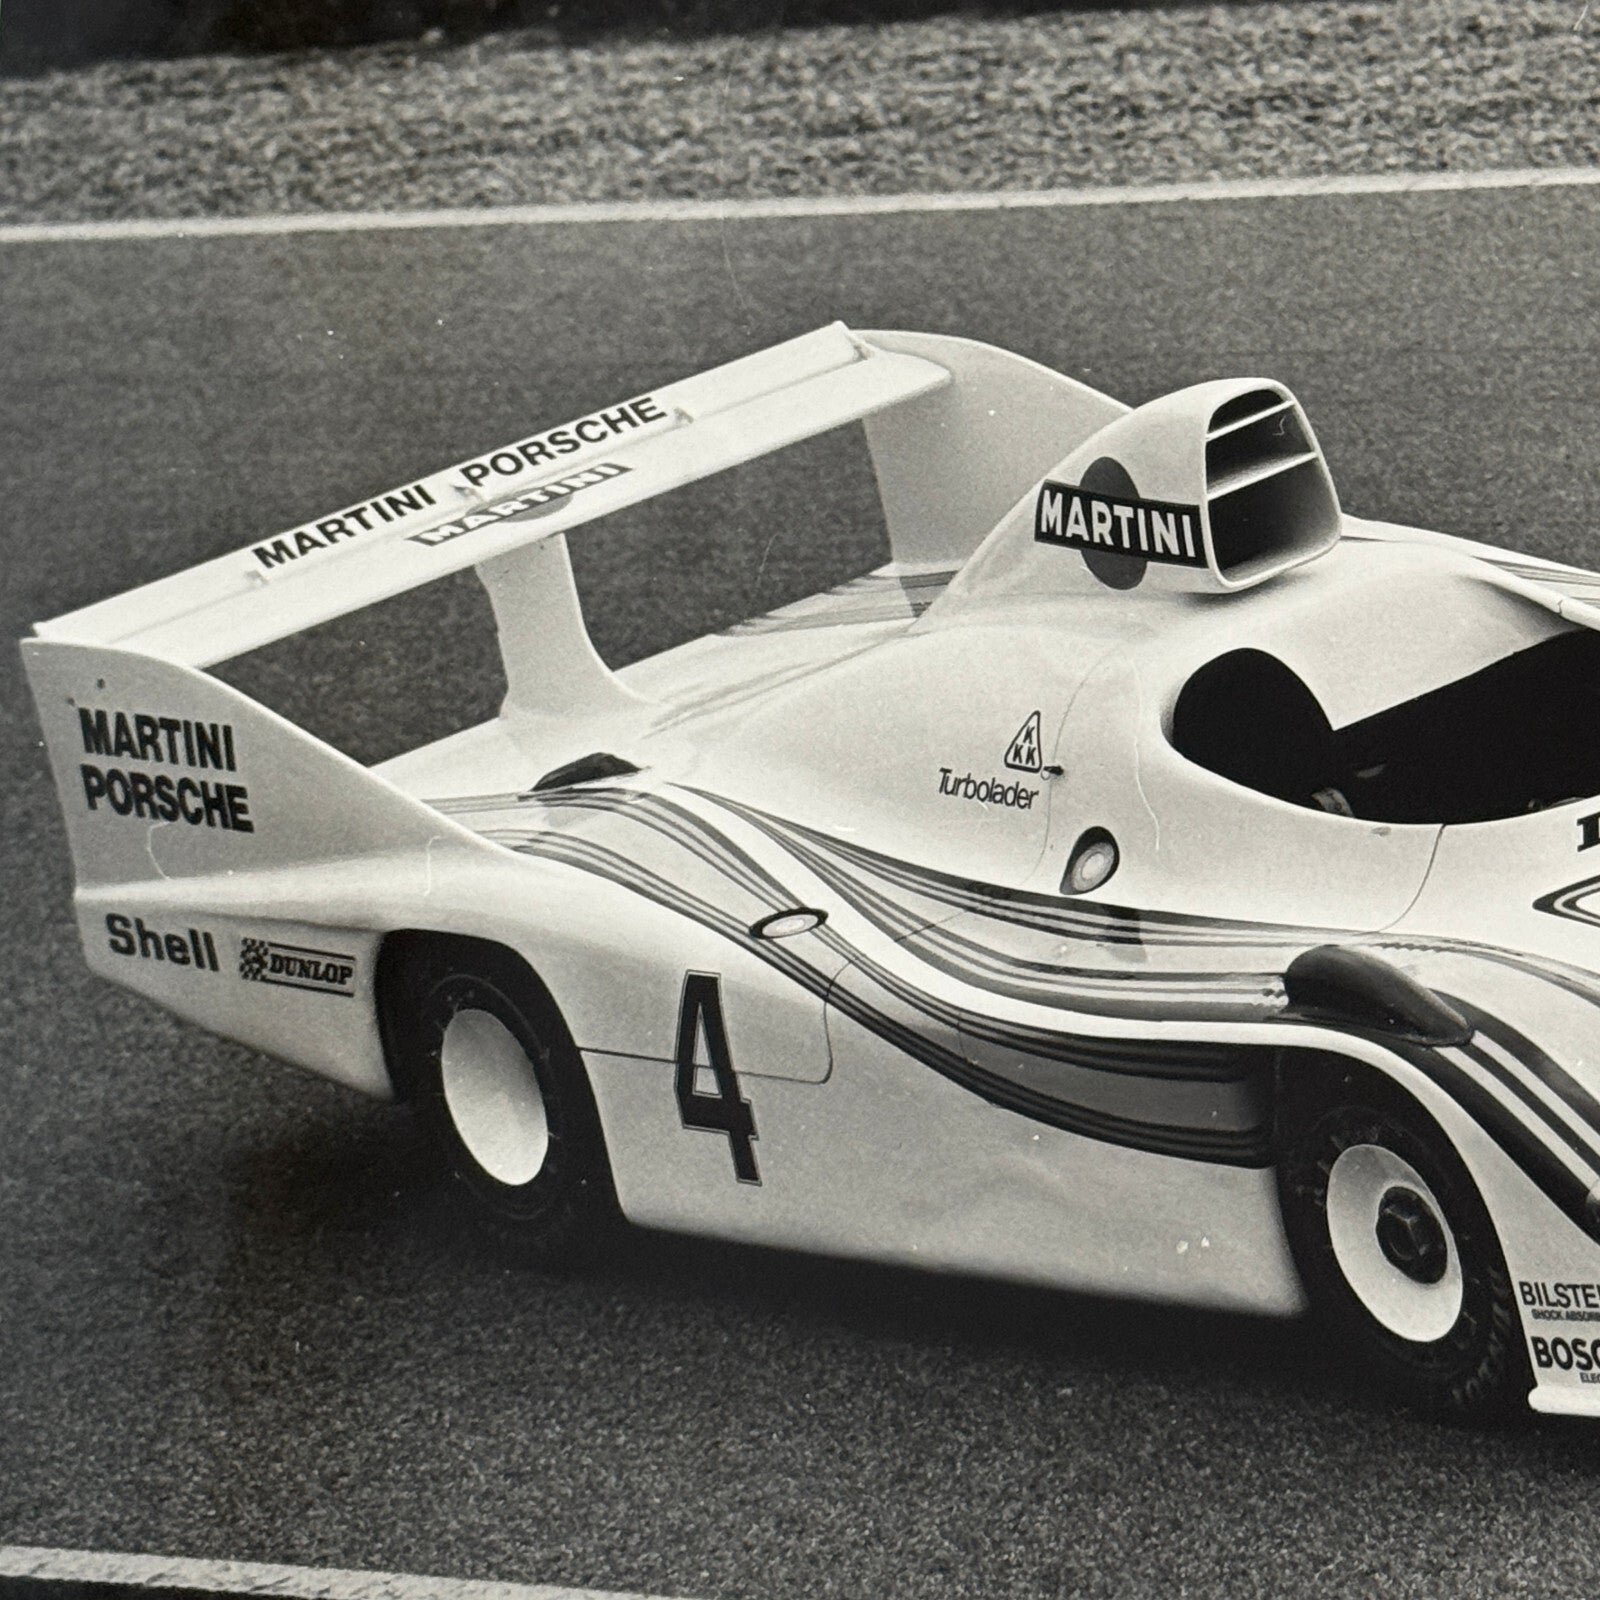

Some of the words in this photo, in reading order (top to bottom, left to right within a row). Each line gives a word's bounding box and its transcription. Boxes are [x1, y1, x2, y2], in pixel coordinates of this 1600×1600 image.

[250, 484, 438, 569] MARTINI
[459, 396, 667, 488] PORSCHE
[419, 462, 624, 544] MARTINI
[1040, 488, 1198, 559] MARTINI
[78, 706, 237, 773] MARTINI
[80, 763, 255, 834] PORSCHE
[938, 766, 1040, 810] Turbolader
[105, 912, 220, 973] Shell
[268, 951, 353, 986] DUNLOP
[673, 968, 763, 1188] 4
